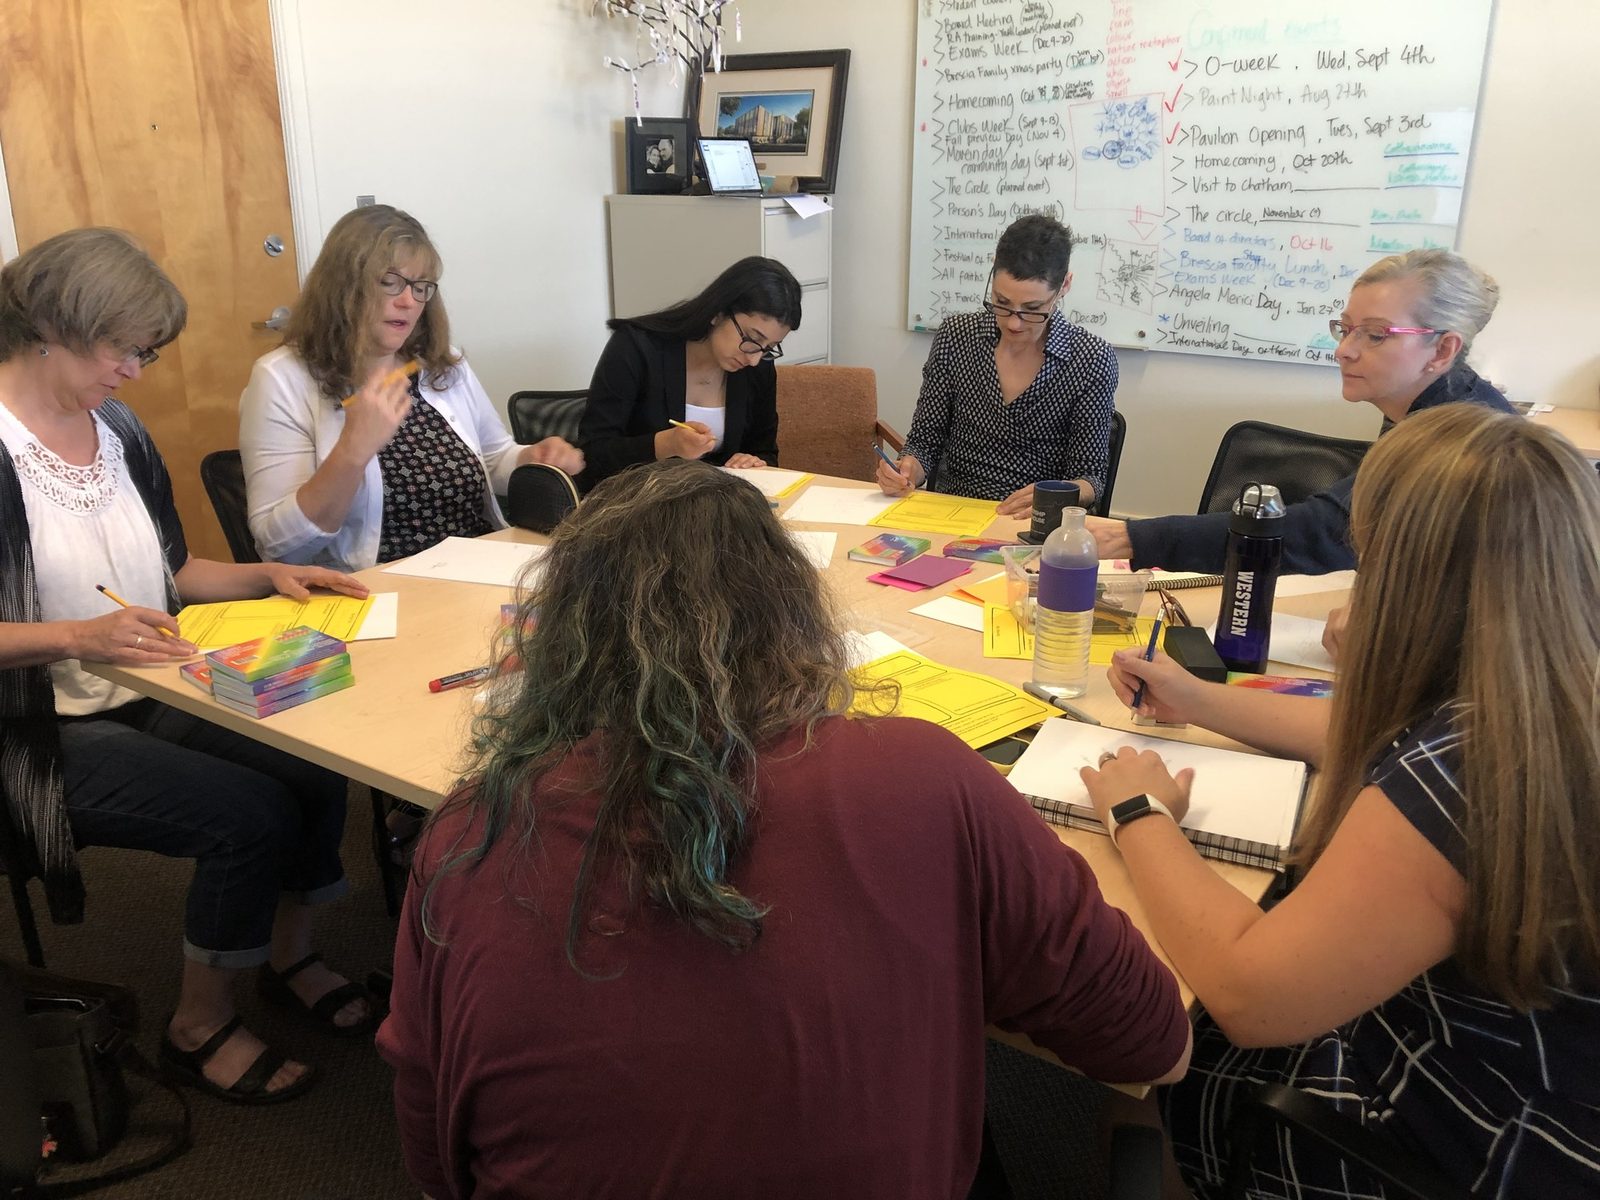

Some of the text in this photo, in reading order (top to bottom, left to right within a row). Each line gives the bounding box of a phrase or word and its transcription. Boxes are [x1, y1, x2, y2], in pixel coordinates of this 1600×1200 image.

[977, 12, 1014, 31] Meeting
[947, 32, 961, 44] RA
[949, 45, 988, 61] Exams
[993, 40, 1028, 56] Week
[1355, 47, 1390, 71] Sept
[1400, 44, 1435, 64] 4th
[1036, 60, 1063, 77] party
[949, 92, 1015, 118] Homecoming
[1300, 84, 1330, 110] Aug
[948, 118, 978, 135] Clubs
[982, 118, 1014, 133] Week
[1190, 124, 1239, 147] Pavilion
[1364, 115, 1393, 138] Sept
[1398, 114, 1432, 133] 3rd
[945, 135, 962, 146] Fall
[967, 134, 1001, 147] preview
[1005, 132, 1024, 148] Day
[1293, 154, 1317, 169] Oct
[1321, 150, 1353, 168] 20th
[945, 176, 960, 195] The
[1193, 176, 1221, 194] Visit
[1225, 177, 1237, 191] to
[948, 202, 984, 218] Person's
[988, 202, 1007, 225] Day
[1186, 204, 1209, 223] The
[1263, 206, 1306, 219] November
[944, 226, 998, 240] International
[1290, 235, 1317, 250] Oct
[1320, 236, 1334, 251] 16
[1180, 250, 1227, 271] Brescia
[941, 267, 955, 280] All
[1174, 270, 1217, 285] Exams
[1169, 286, 1211, 307] Angela
[1297, 301, 1315, 315] Jan
[1173, 314, 1230, 336] Unveiling
[1167, 331, 1229, 350] International
[1232, 340, 1254, 356] Day
[1230, 571, 1255, 637] WESTERN
